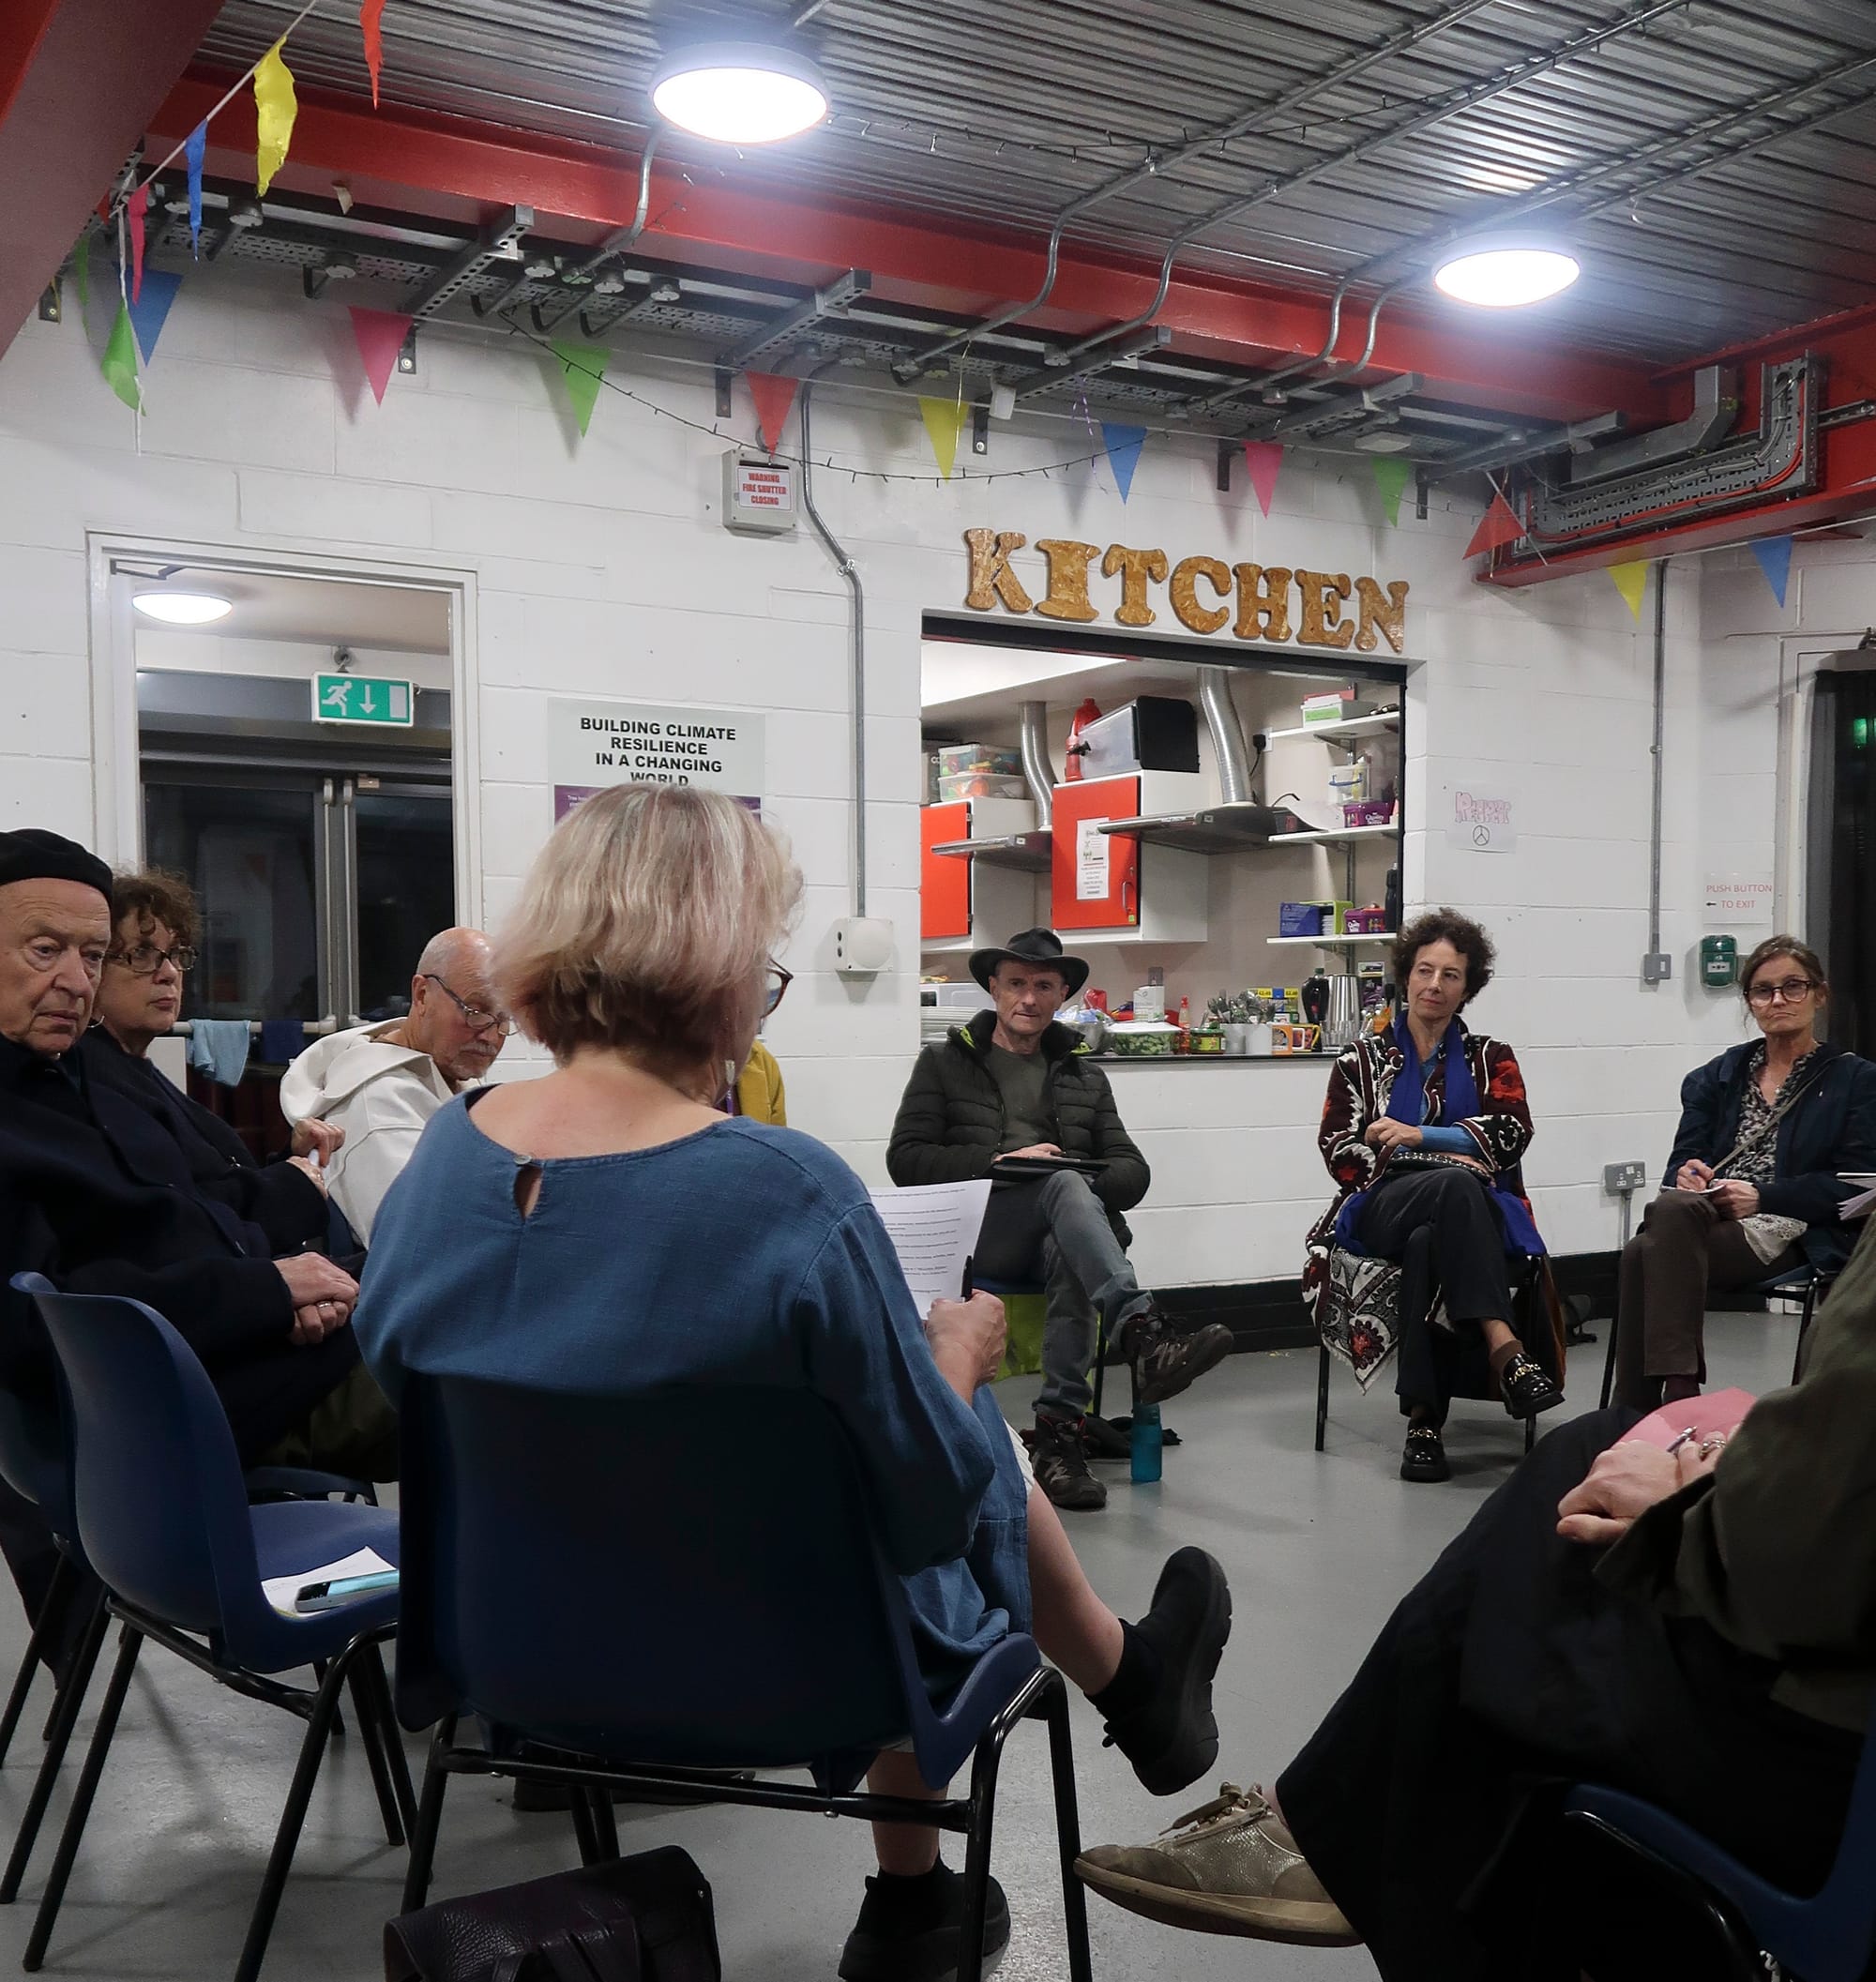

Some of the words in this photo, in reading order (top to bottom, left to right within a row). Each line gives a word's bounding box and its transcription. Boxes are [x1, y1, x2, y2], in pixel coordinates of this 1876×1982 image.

[749, 473, 780, 483] WARNING
[743, 483, 756, 492] FIRE
[758, 484, 786, 494] SHUTTER
[751, 495, 779, 506] CLOSING
[962, 527, 1410, 654] KITCHEN
[580, 717, 660, 735] BUILDING
[666, 722, 737, 741] CLIMATE
[610, 735, 708, 756] RESILIENCE
[595, 752, 613, 766] IN
[618, 753, 630, 767] A
[635, 754, 722, 774] CHANGING
[1705, 885, 1732, 893] PUSH
[1733, 884, 1773, 893] BUTTON
[1720, 900, 1733, 909] TO
[1736, 900, 1757, 909] EXIT
